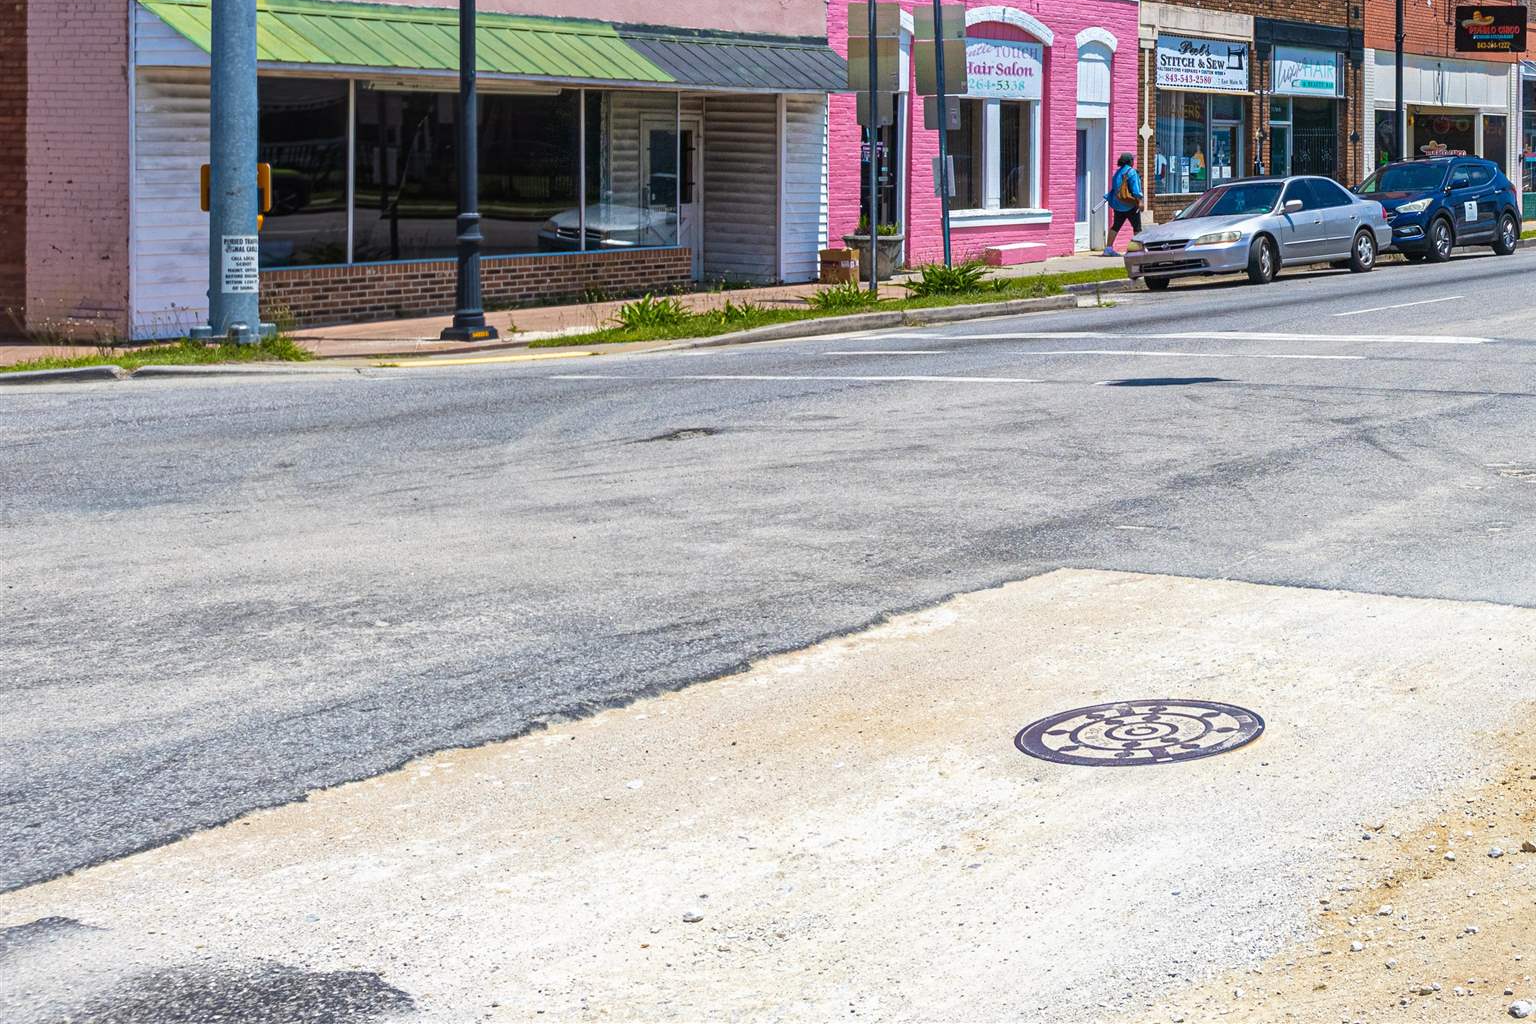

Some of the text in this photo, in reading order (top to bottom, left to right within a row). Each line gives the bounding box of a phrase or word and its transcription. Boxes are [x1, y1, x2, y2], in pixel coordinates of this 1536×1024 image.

[995, 61, 1034, 77] Salon
[1160, 53, 1225, 70] STITCH & SEW
[1165, 73, 1212, 85] 843-543-2580
